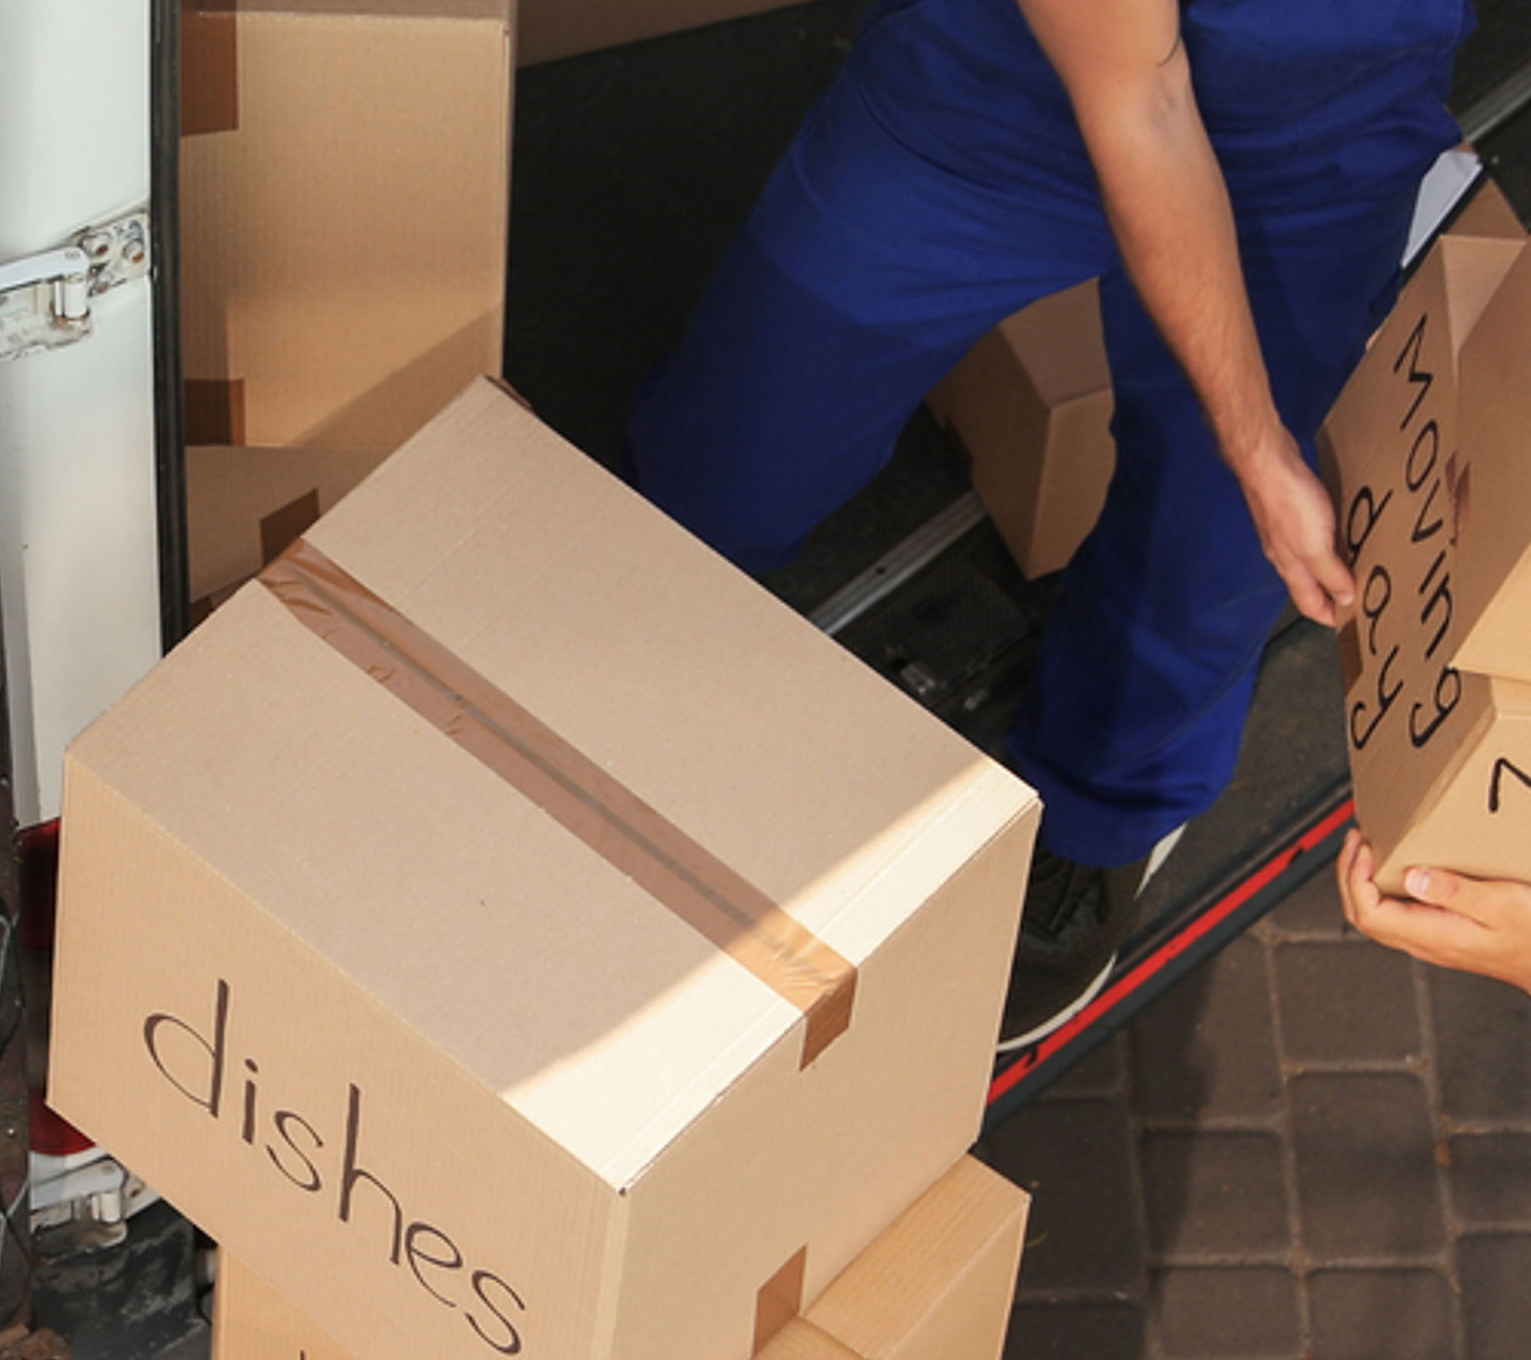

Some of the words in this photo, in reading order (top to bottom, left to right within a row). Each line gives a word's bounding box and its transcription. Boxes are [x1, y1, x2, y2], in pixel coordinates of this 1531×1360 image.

[1346, 485, 1405, 751] day
[1392, 313, 1462, 748] Moving
[142, 978, 528, 1356] dishes
